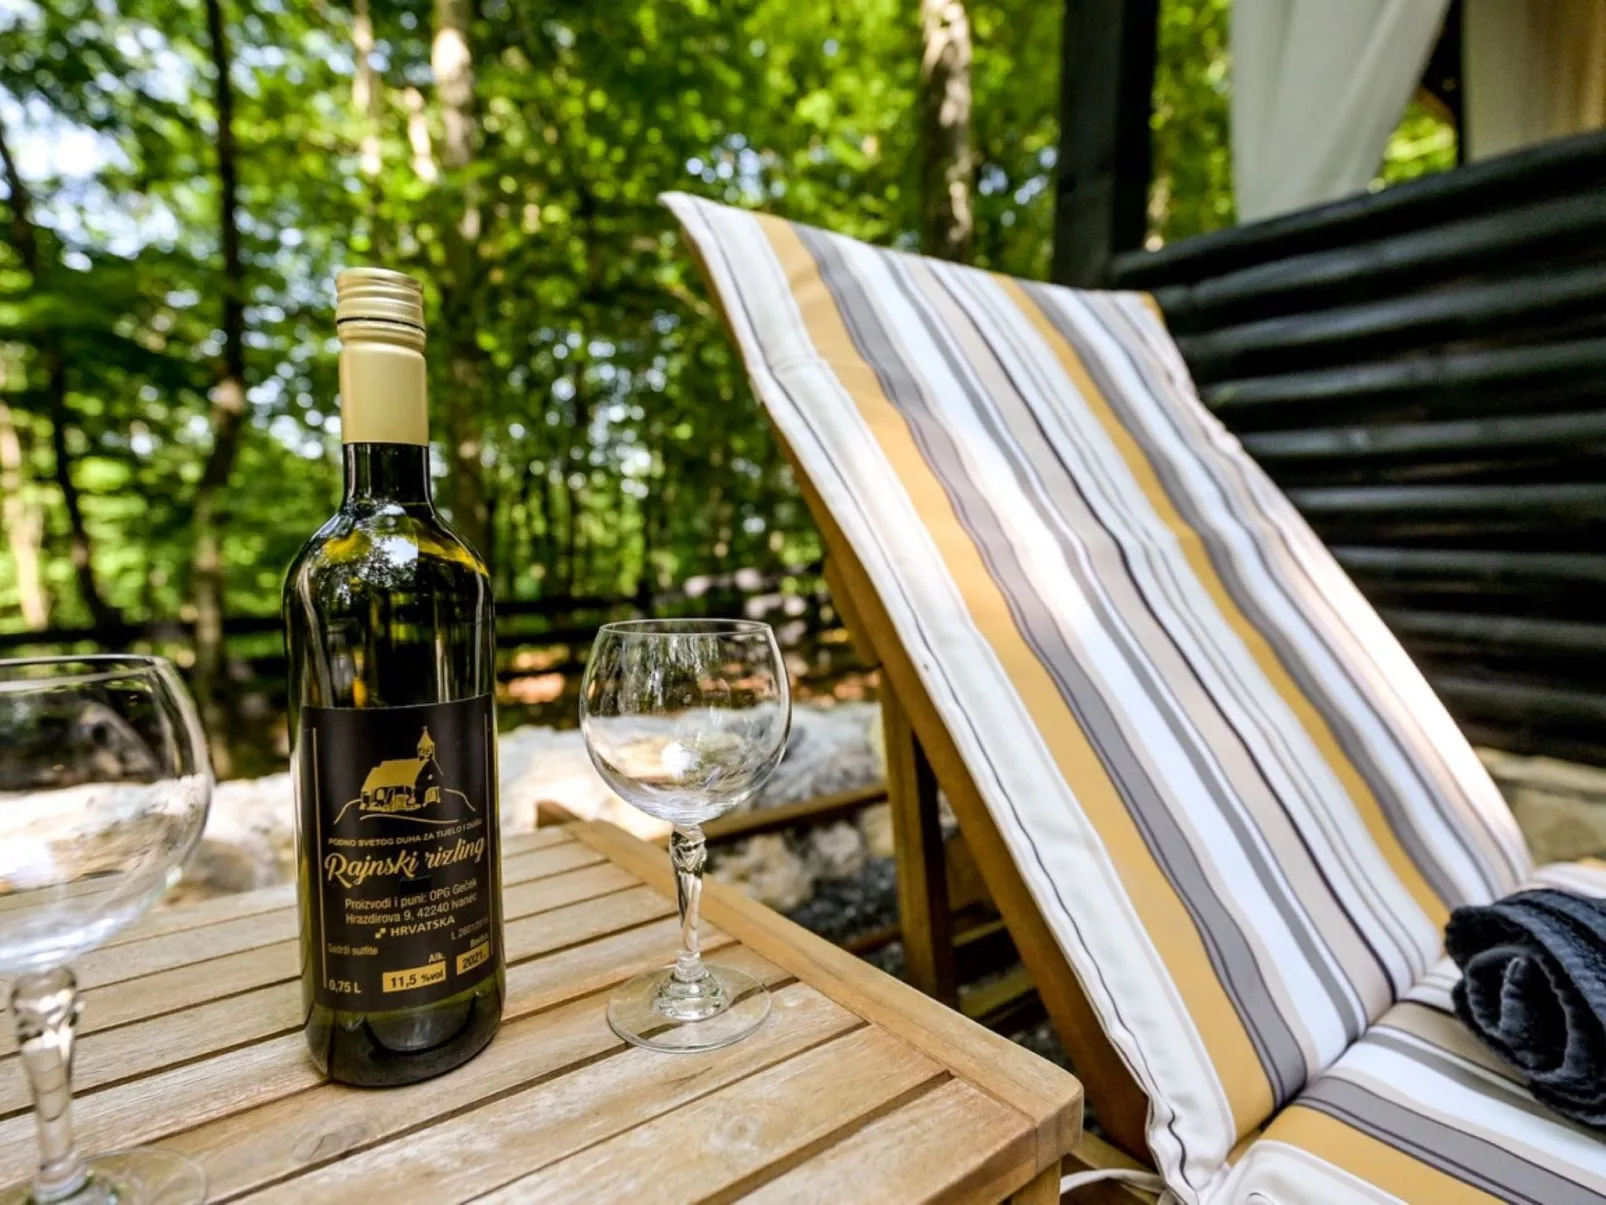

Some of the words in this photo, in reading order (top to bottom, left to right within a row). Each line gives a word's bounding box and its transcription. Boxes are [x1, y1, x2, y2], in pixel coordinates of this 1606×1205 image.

[358, 838, 394, 847] SVETOG
[396, 836, 421, 845] DUHA
[423, 832, 434, 841] ZA
[324, 849, 419, 889] Rajnski
[425, 837, 485, 870] rizling
[345, 897, 392, 910] Proizvodi
[394, 896, 398, 907] i
[400, 893, 427, 911] puni:
[429, 886, 450, 902] OPG
[346, 912, 400, 925] Hrazdirova
[416, 901, 449, 920] 42240
[390, 915, 455, 937] HRVATSKA
[352, 945, 378, 956] sulfite
[329, 979, 351, 994] 0,75
[354, 982, 362, 994] L
[391, 974, 417, 988] 11,5
[421, 970, 443, 983] %vol
